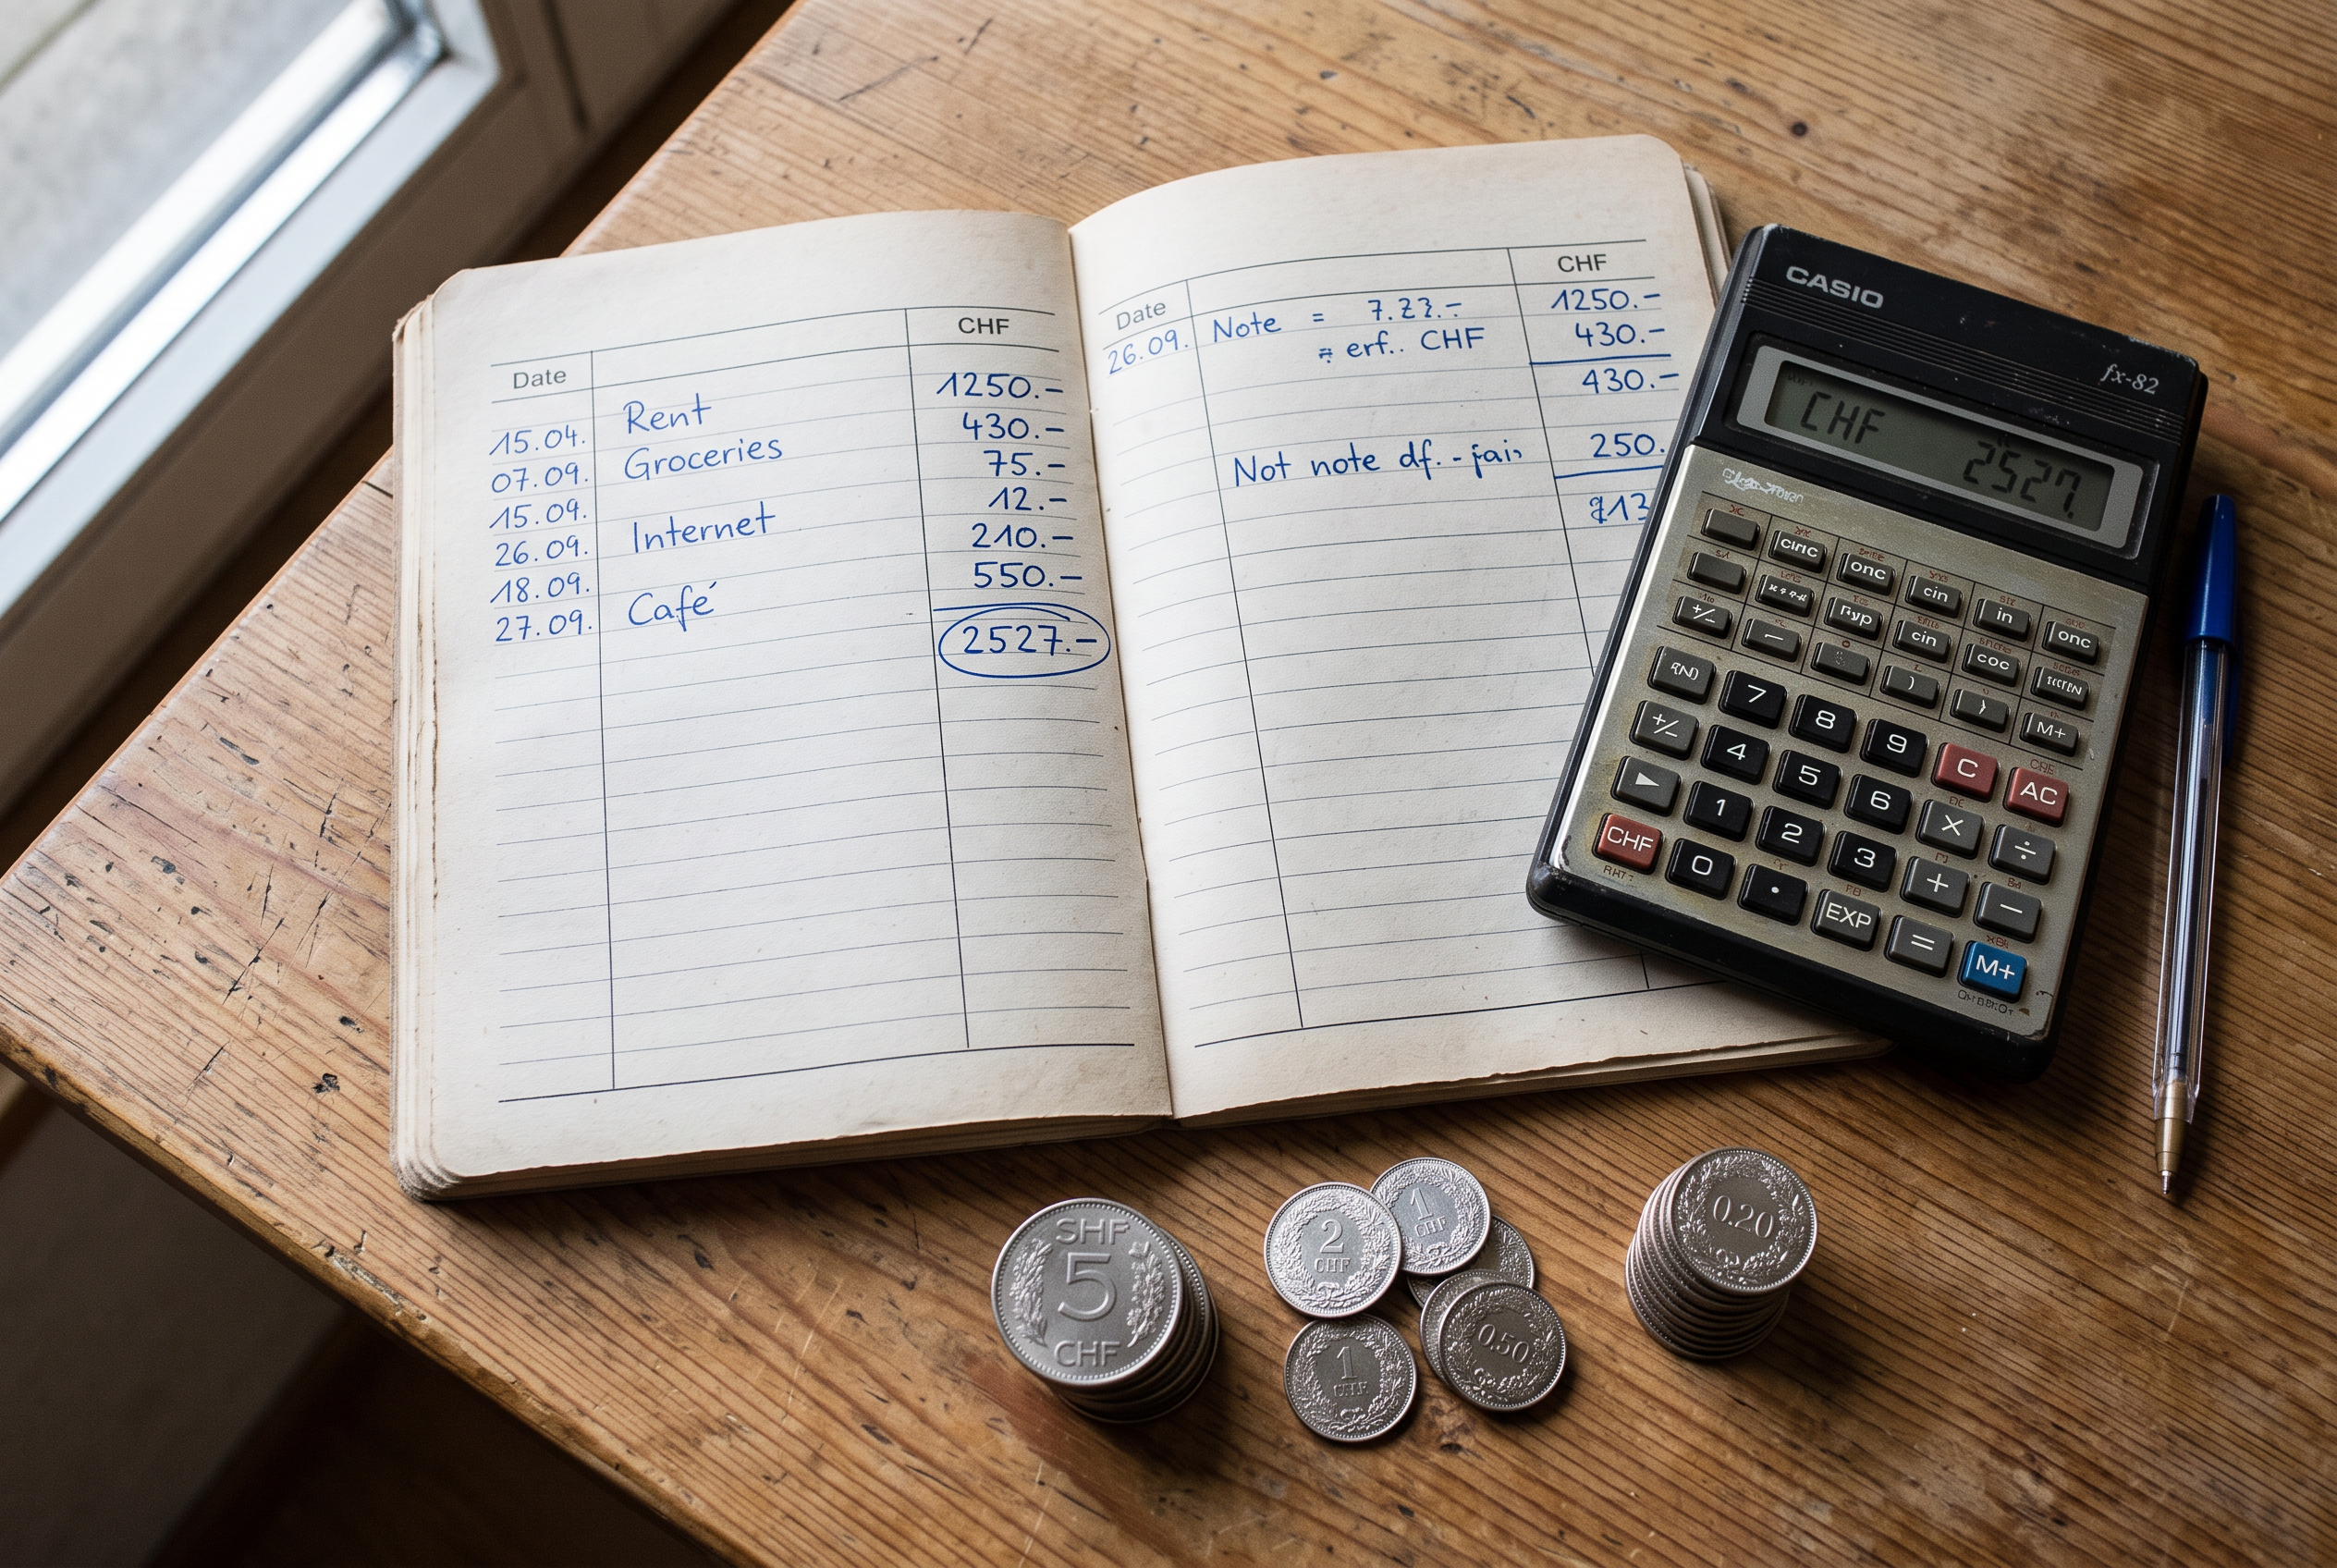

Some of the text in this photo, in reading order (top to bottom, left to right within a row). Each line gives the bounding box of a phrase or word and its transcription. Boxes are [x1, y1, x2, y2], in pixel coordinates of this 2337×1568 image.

[1557, 254, 1607, 273] CHF
[1551, 288, 1660, 311] 1250.-
[1786, 265, 1884, 309] CASIO
[958, 317, 1009, 335] CHF
[1116, 300, 1167, 330] Date
[1107, 329, 1189, 374] 26.09.
[1213, 312, 1282, 343] Note
[1575, 322, 1665, 347] 430.-
[1420, 327, 1486, 351] CHF
[513, 369, 567, 389] Date
[2099, 363, 2160, 395] fx-82
[489, 373, 1063, 455] 15.04. Rent 1250.-
[1799, 391, 1887, 445] CHF
[492, 411, 1064, 493] 07.09. Groceries 430.-
[1234, 451, 1292, 487] Not
[1311, 442, 1381, 476] note
[489, 450, 1065, 529] 15.09. 75.-
[496, 487, 1067, 566] 26.09. Internet 12.-
[490, 523, 1073, 603] 18.09. 210.-
[496, 562, 1082, 642] 27.09. Café 550.-
[1923, 586, 1949, 603] cin
[1996, 608, 2013, 624] in
[2058, 630, 2092, 649] onc
[963, 626, 1097, 656] 2527.-
[1911, 631, 1937, 647] cin
[1976, 654, 2010, 670] coc
[1748, 684, 1767, 703] 7
[1815, 709, 1836, 729] 8
[1886, 733, 1908, 753] 9
[1957, 758, 1979, 778] C
[2020, 781, 2058, 806] AC
[2037, 721, 2066, 739] M+
[1726, 743, 1746, 761] 4
[1798, 765, 1821, 785] 5
[1870, 790, 1891, 811] 6
[1716, 799, 1726, 816] 1
[1781, 823, 1803, 844] 2
[1854, 848, 1877, 869] 3
[1607, 826, 1654, 852] CHF
[1691, 854, 1713, 876] 0
[1826, 901, 1872, 928] EXP
[1976, 954, 2015, 980] M+
[1410, 1187, 1434, 1220] 1
[1713, 1194, 1774, 1239] 0.20
[1319, 1219, 1344, 1253] 2
[1058, 1252, 1117, 1322] 5
[1314, 1257, 1351, 1273] CHF
[1054, 1340, 1120, 1367] CHF
[1337, 1346, 1358, 1379] 1
[1478, 1323, 1530, 1364] 0.50
